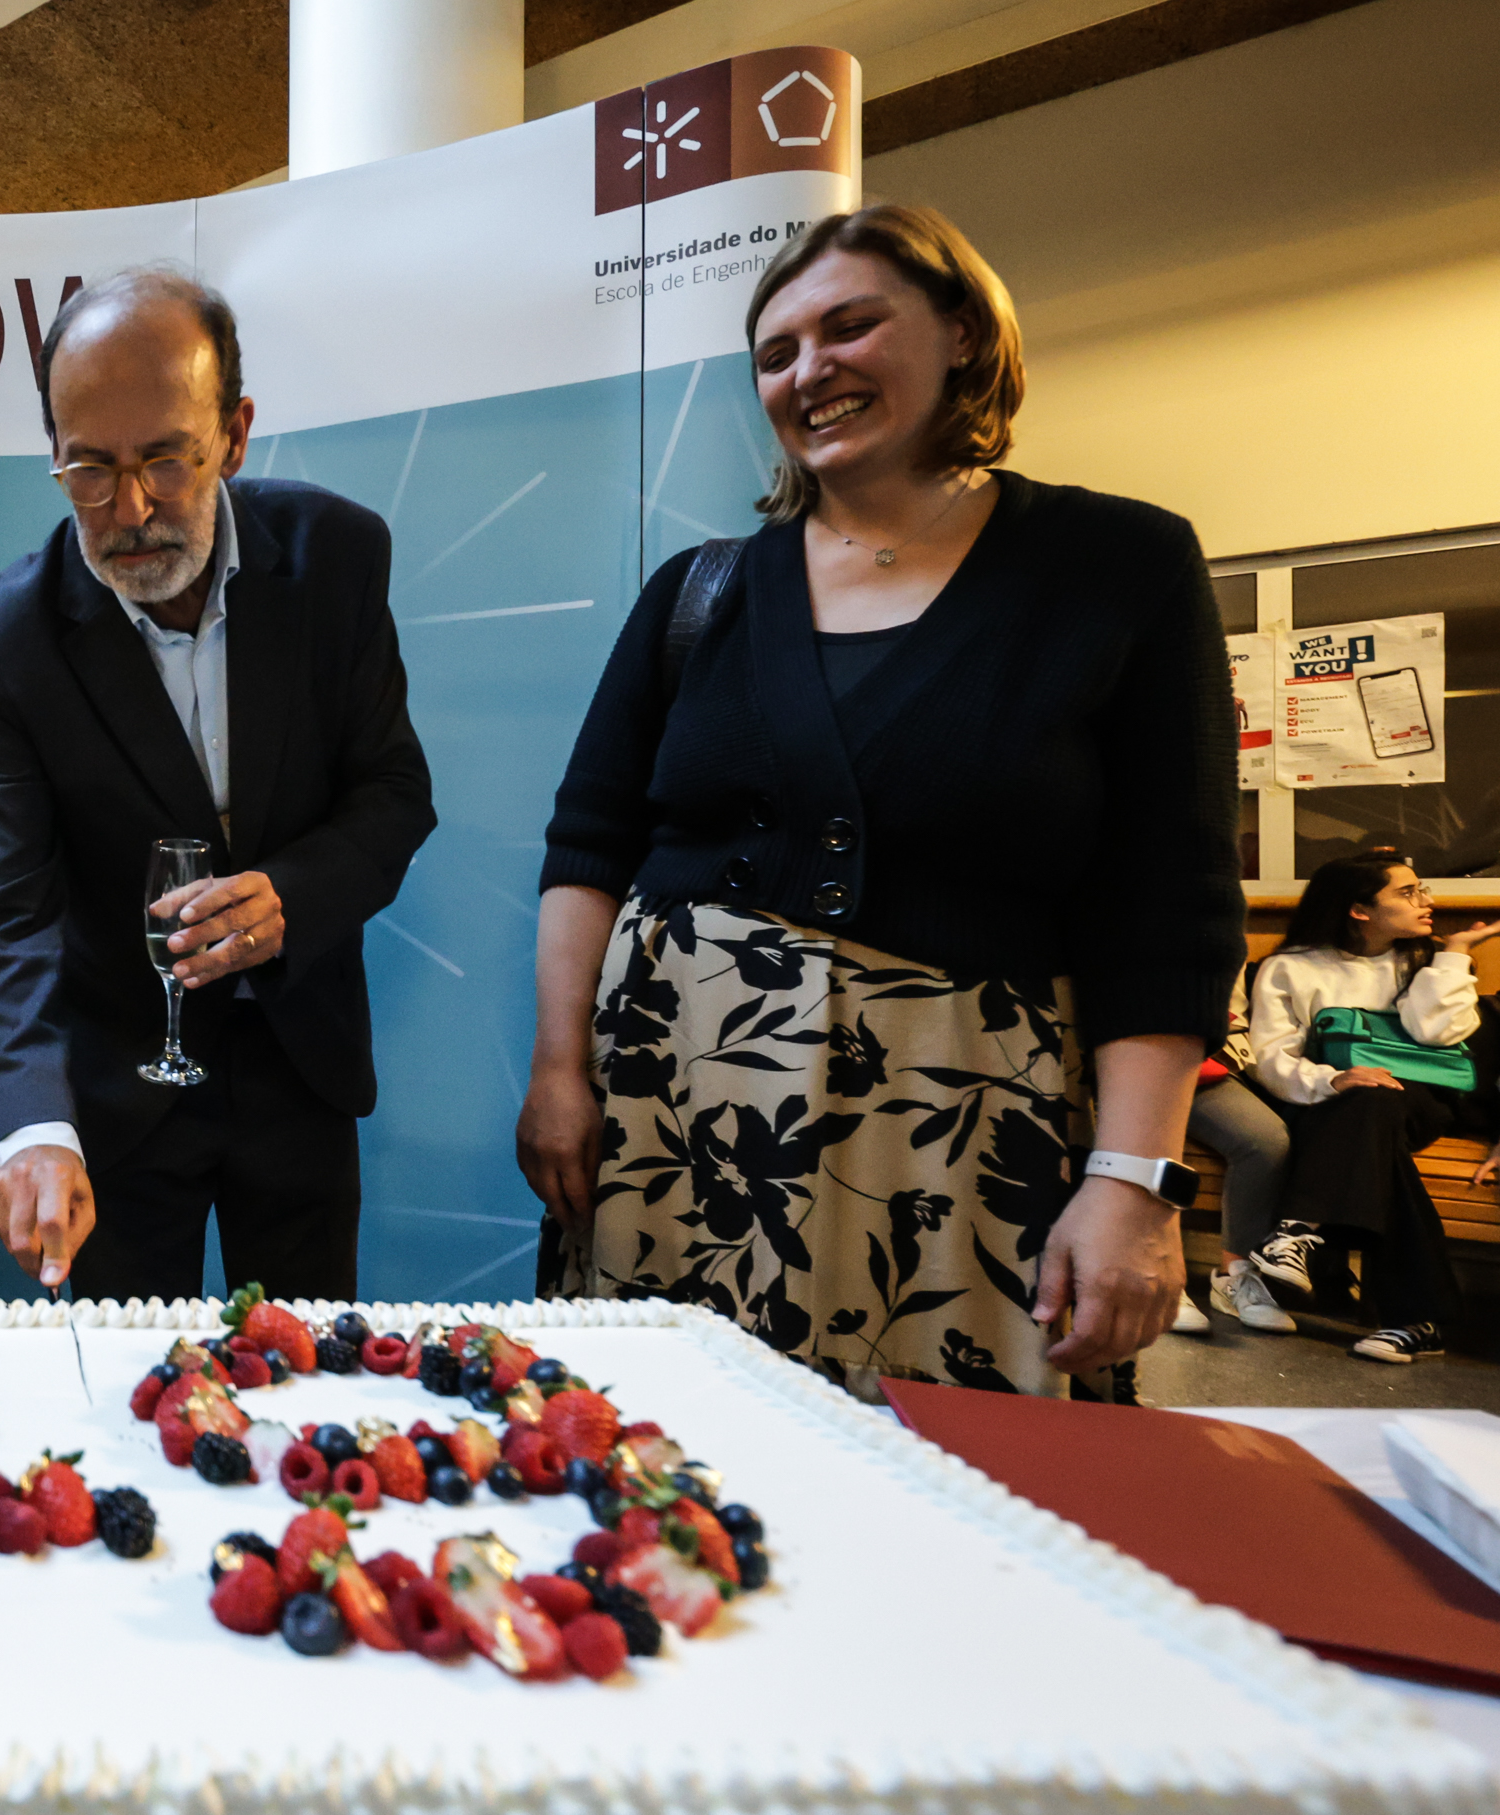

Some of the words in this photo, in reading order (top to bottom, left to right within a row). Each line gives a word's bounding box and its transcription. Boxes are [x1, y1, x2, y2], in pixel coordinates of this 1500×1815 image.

[595, 232, 741, 277] Universidade
[749, 225, 778, 244] do
[595, 273, 654, 305] Escola
[661, 273, 685, 292] de
[693, 253, 776, 284] Engenh
[1304, 637, 1327, 648] WE
[1289, 646, 1347, 660] WANT
[1300, 660, 1346, 675] YOU
